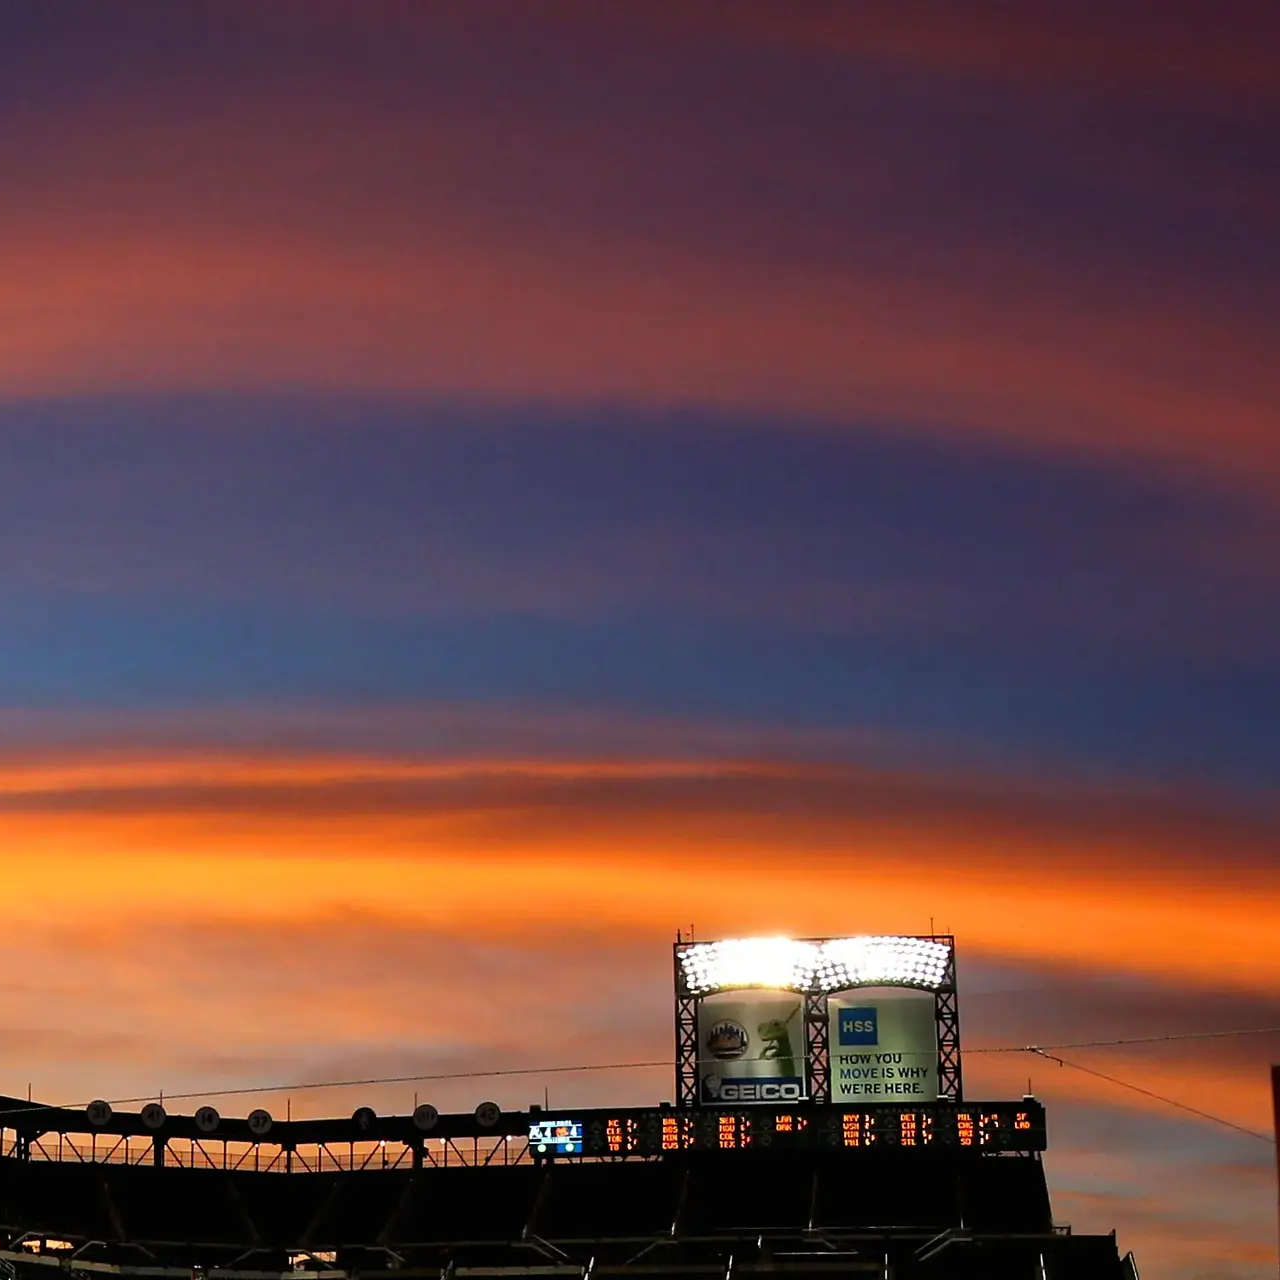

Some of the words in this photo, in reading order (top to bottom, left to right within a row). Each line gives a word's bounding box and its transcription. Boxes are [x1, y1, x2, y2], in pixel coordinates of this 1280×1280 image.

[843, 1021, 873, 1032] HSS
[840, 1054, 873, 1064] HOW
[875, 1053, 902, 1064] YOU
[840, 1068, 878, 1079] MOVE
[881, 1068, 894, 1078] IS
[899, 1067, 928, 1078] WHY
[721, 1084, 799, 1100] GEICO
[840, 1083, 880, 1094] WE'RE
[885, 1083, 924, 1094] HERE.
[1016, 1113, 1026, 1121] SF
[607, 1135, 622, 1143] TOR
[663, 1134, 677, 1142] MIN
[719, 1140, 735, 1148] TEX
